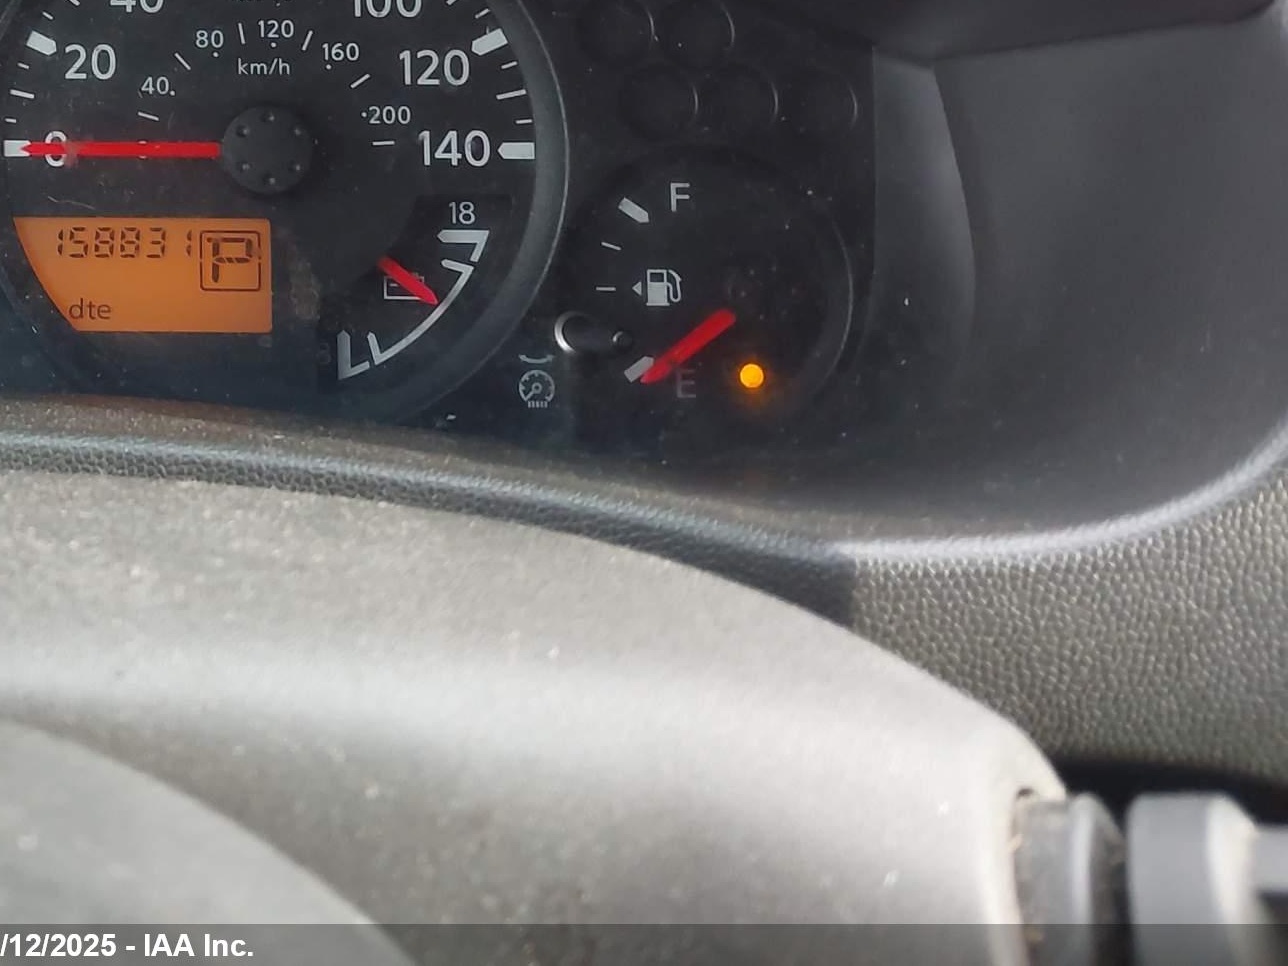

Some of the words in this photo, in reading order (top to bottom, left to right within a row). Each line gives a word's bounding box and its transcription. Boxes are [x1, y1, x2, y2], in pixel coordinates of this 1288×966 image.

[195, 29, 224, 48] 80
[258, 19, 294, 38] 120
[65, 44, 116, 80] 20
[322, 42, 360, 61] 160
[237, 57, 291, 76] km/h
[399, 49, 470, 86] 120
[141, 76, 170, 95] 40
[369, 105, 411, 125] 200
[44, 130, 67, 168] 0
[419, 130, 491, 167] 140
[670, 182, 691, 212] F
[448, 201, 476, 225] 18
[57, 225, 192, 259] 158831
[207, 236, 255, 283] P
[68, 297, 112, 320] dte
[675, 368, 698, 400] E
